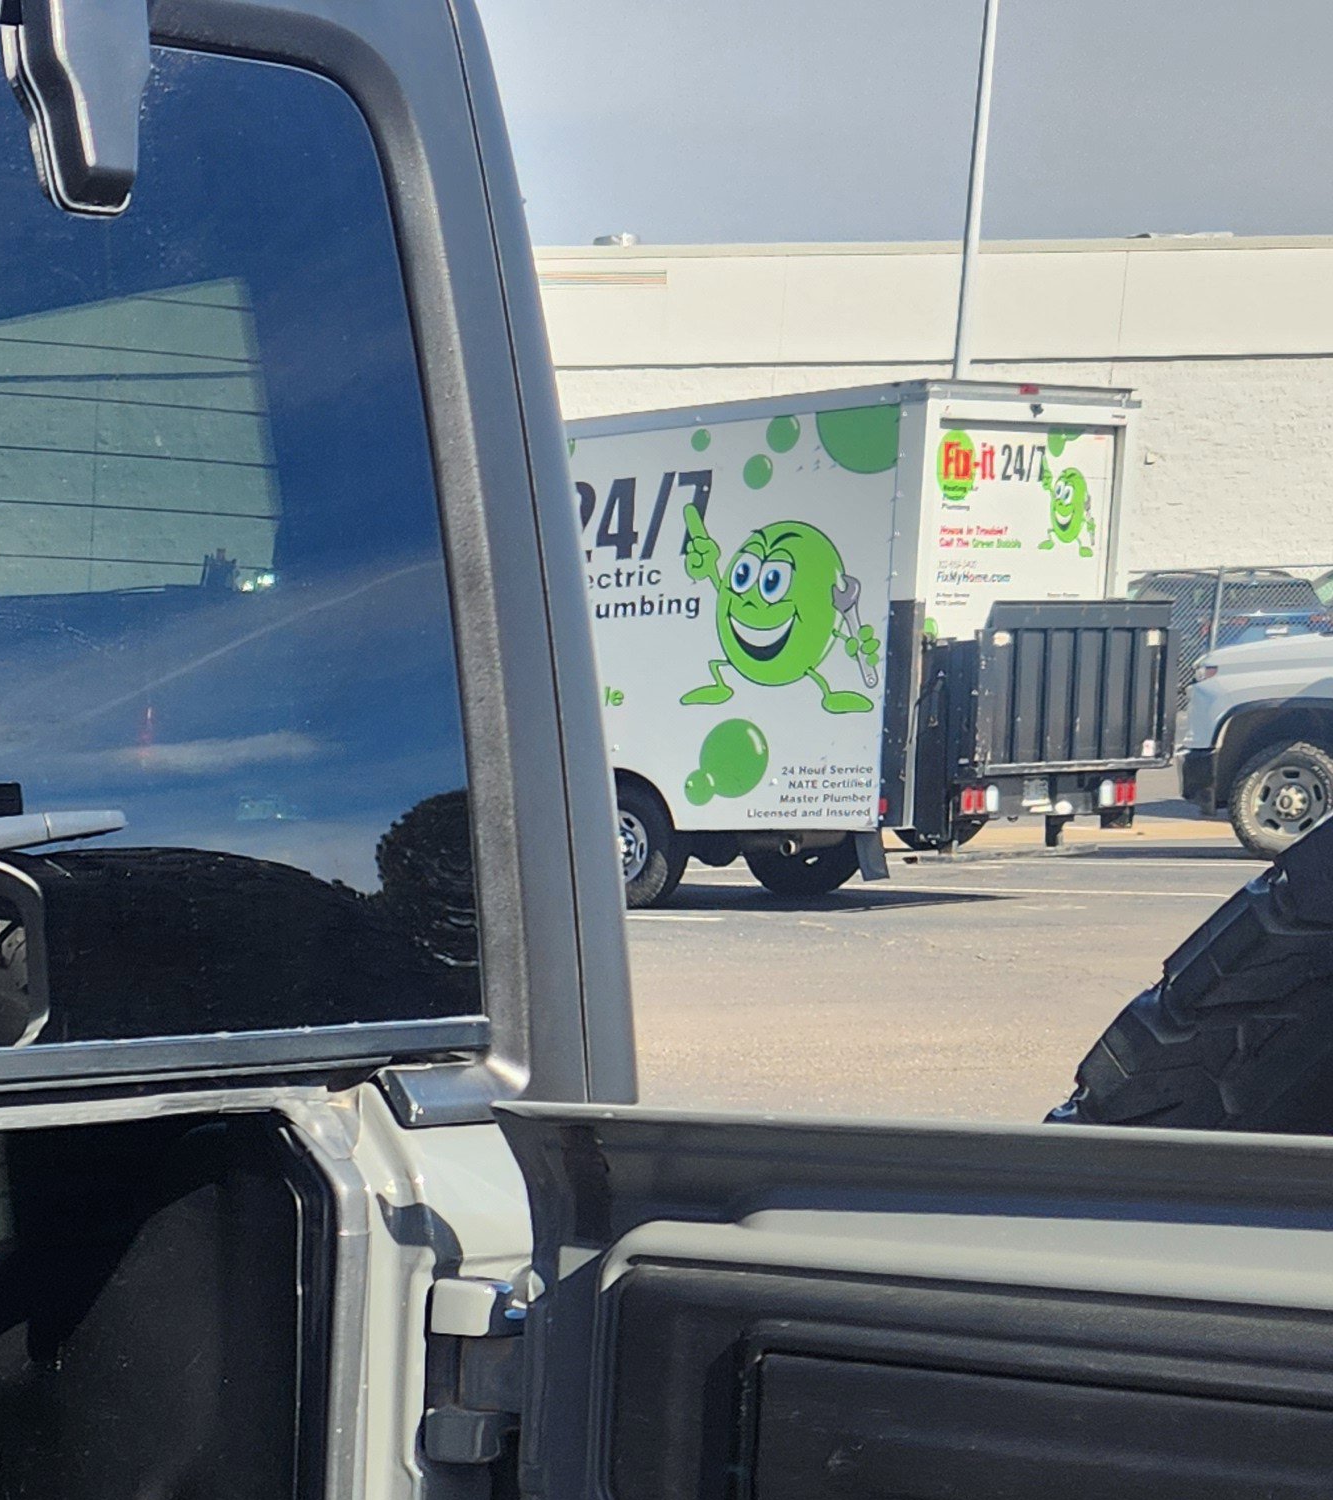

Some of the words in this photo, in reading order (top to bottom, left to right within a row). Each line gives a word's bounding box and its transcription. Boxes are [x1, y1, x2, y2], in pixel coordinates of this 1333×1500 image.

[1001, 444, 1046, 482] 24/7
[936, 571, 1011, 585] FixMyHome.com
[781, 766, 794, 775] 24
[830, 765, 873, 775] Service
[788, 780, 818, 789] NATE
[822, 779, 873, 789] Certified
[779, 794, 819, 803] Master
[822, 793, 872, 803] Plumber
[747, 808, 797, 818] Licensed
[801, 808, 823, 817] and
[826, 806, 871, 817] Insured
